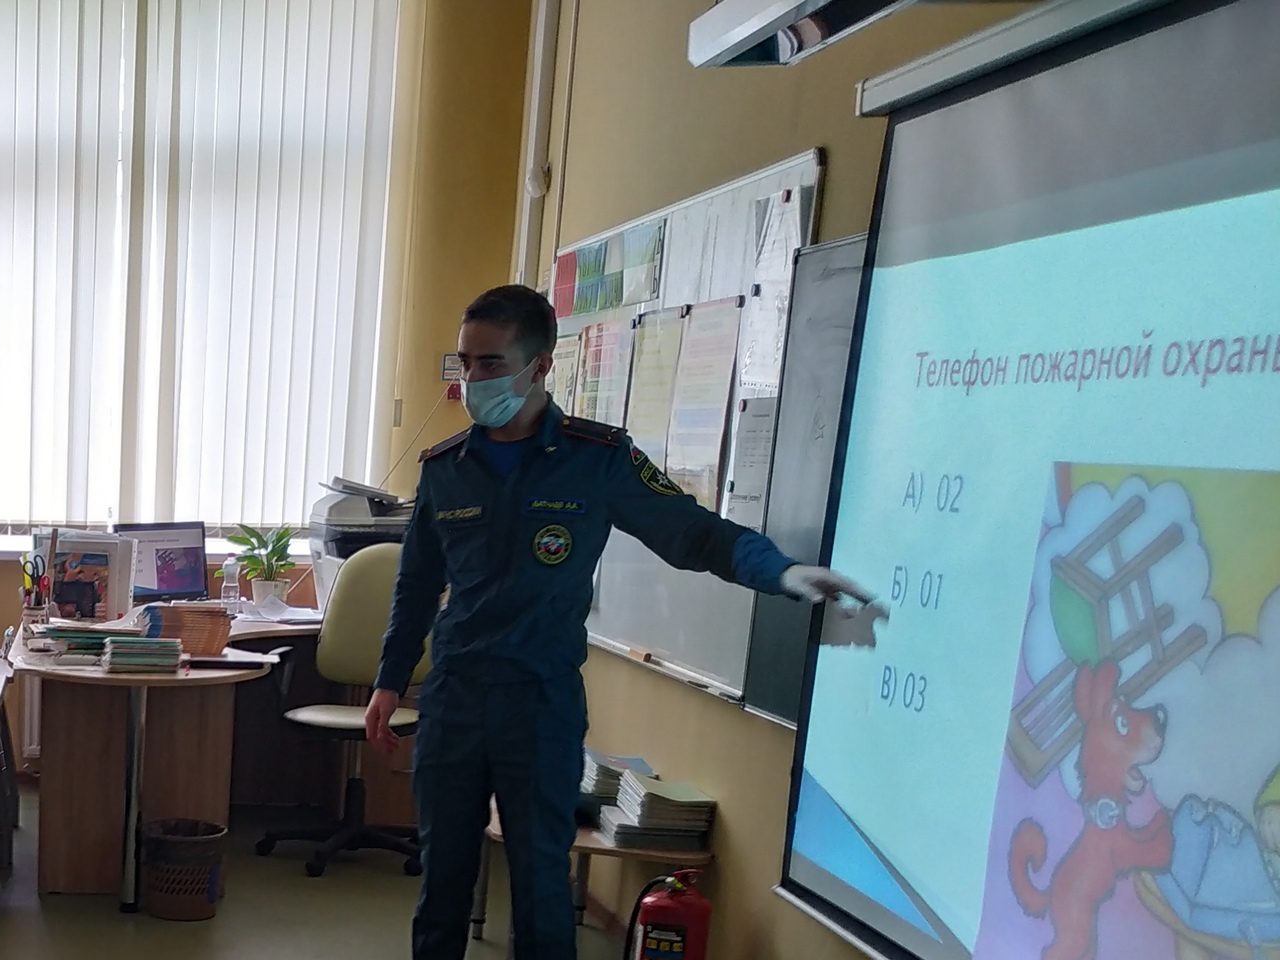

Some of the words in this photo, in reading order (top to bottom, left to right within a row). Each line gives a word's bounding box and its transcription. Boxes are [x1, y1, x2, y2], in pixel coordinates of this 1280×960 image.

[915, 349, 1009, 396] Телефон
[1015, 328, 1155, 392] пожарной
[902, 472, 925, 513] А)
[936, 474, 964, 513] 02
[891, 566, 908, 608] Б)
[920, 570, 943, 610] 01
